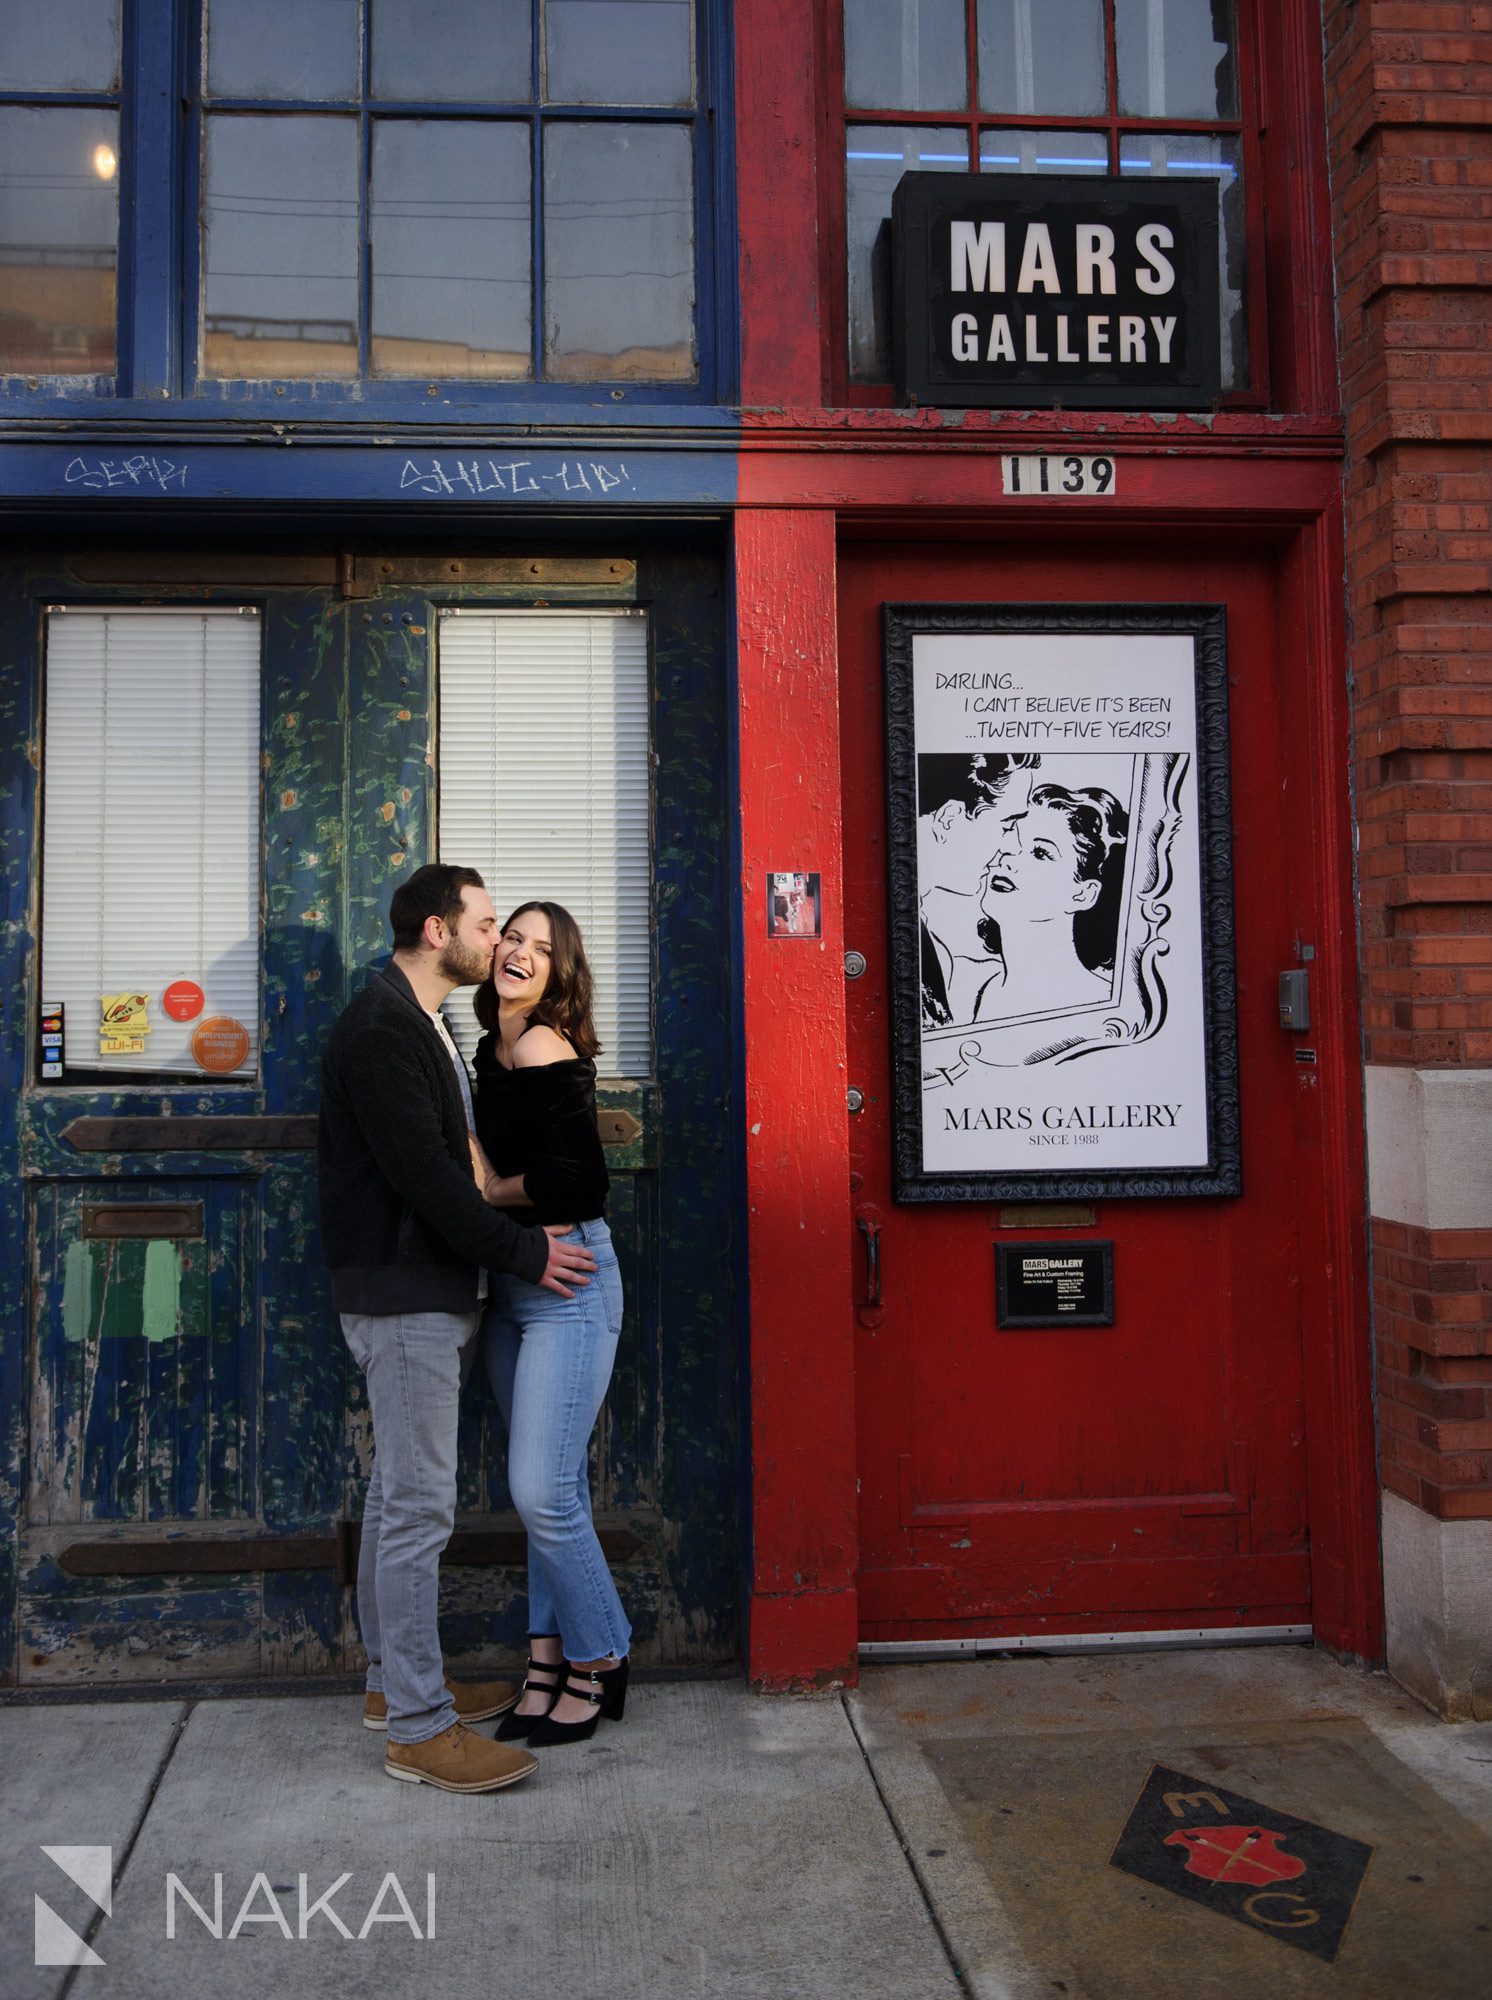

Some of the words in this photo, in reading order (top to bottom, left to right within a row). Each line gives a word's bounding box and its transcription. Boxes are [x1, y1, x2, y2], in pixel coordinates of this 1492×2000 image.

[951, 221, 1175, 295] MARS
[951, 313, 1177, 363] GALLERY
[1011, 457, 1113, 493] 1139
[935, 672, 1024, 690] DARLING...
[964, 697, 969, 712] I
[1025, 697, 1092, 713] BELIEVE
[1095, 697, 1124, 713] IT'S
[1128, 697, 1171, 713] BEEN
[965, 720, 1103, 738] ...TWENTY-FIVE
[1107, 720, 1172, 738] YEARS!
[943, 1107, 1033, 1131] MARS
[1042, 1104, 1183, 1129] GALLERY
[1028, 1134, 1069, 1146] SINCE
[1073, 1134, 1099, 1145] 1988
[1024, 1260, 1047, 1269] MARS
[1049, 1259, 1083, 1268] GALLERY
